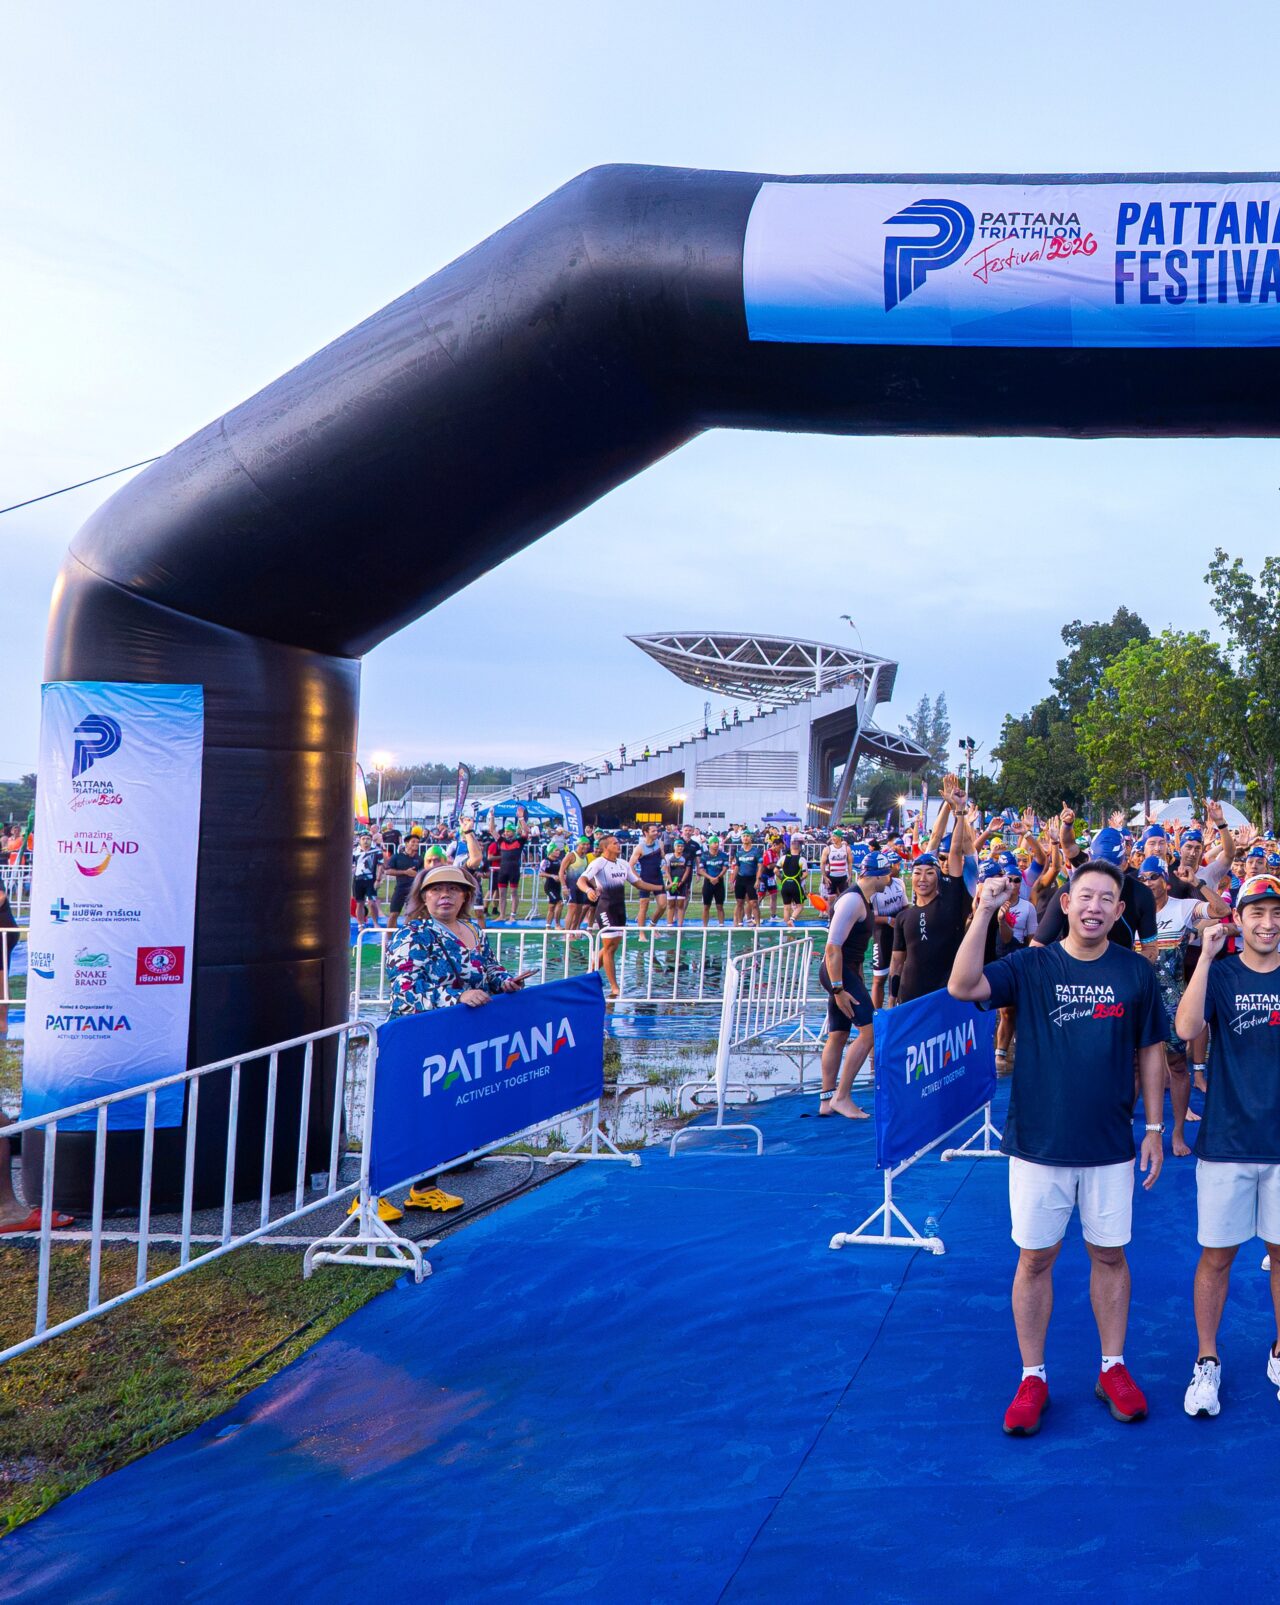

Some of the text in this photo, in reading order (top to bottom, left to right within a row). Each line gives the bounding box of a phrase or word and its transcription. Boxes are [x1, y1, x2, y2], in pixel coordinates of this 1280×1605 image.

[980, 212, 1080, 225] PATTANA
[979, 227, 1081, 239] TRIATHLON
[964, 232, 1097, 284] Festival 2026
[74, 830, 113, 840] amazing
[57, 841, 139, 854] THAILAND
[884, 895, 902, 906] NAVY
[31, 952, 54, 960] POCARI
[31, 959, 51, 967] SWEAT
[75, 970, 107, 978] SNAKE
[1056, 985, 1114, 995] PATTANA
[1056, 993, 1115, 1003] TRIATHLON
[1049, 1001, 1095, 1027] Festival
[46, 1015, 132, 1031] PATTANA
[1229, 1009, 1271, 1035] Festival
[423, 1016, 576, 1098] PATTANA
[906, 1019, 977, 1085] PATTANA
[455, 1065, 550, 1107] ACTIVELY TOGETHER
[921, 1066, 966, 1098] ACTIVELY TOGETHER
